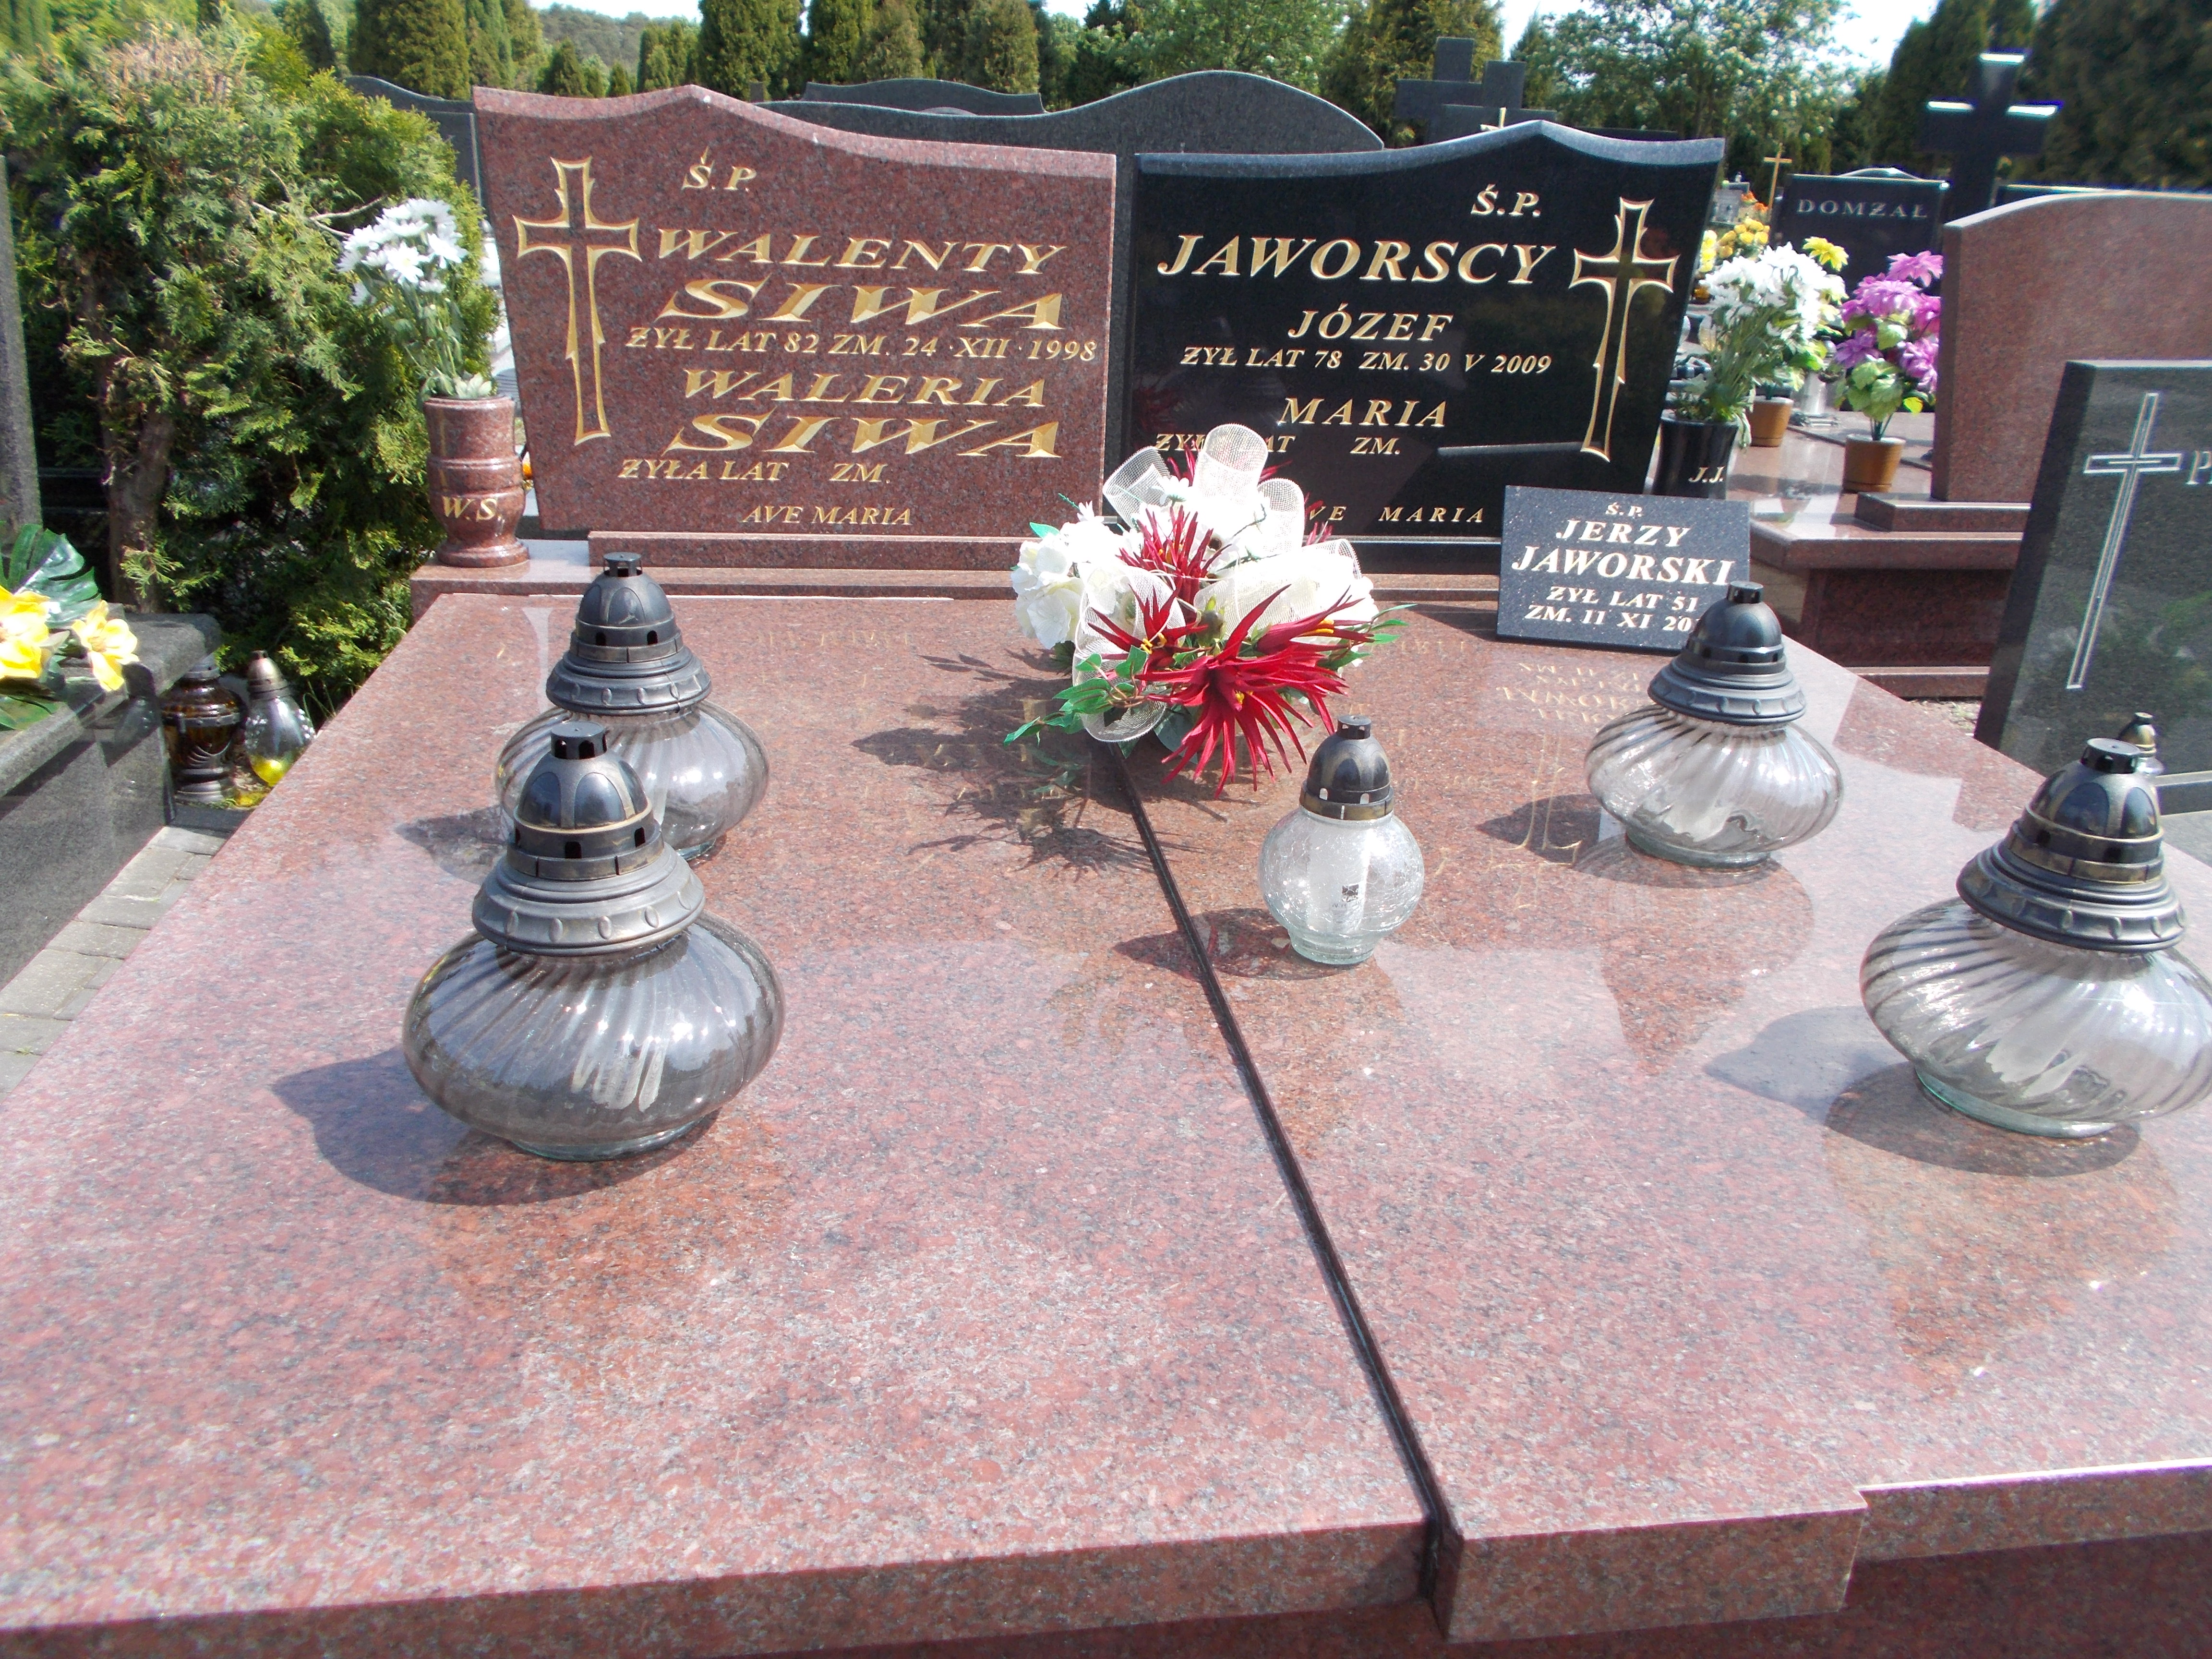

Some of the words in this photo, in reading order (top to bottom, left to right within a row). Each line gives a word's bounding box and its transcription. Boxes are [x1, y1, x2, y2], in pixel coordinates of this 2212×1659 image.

[658, 228, 1067, 275] WALENTY
[1158, 234, 1554, 285] JAWORSCY
[654, 272, 1064, 329] SIWA
[1288, 303, 1453, 342] JÓZEF
[705, 330, 777, 351] LAT
[784, 332, 819, 353] 82
[828, 334, 889, 356] ZM.
[1245, 348, 1305, 367] LAT
[1315, 350, 1342, 368] 78
[1358, 351, 1409, 371] ZM.
[1419, 352, 1451, 372] 30
[1465, 354, 1486, 373] V
[1491, 355, 1551, 373] 2009
[684, 369, 1045, 407] WALERIA
[1278, 397, 1447, 427] MARIA
[661, 407, 1061, 458] SIWA
[1349, 436, 1401, 455] ZM.
[719, 460, 790, 481] LAT
[829, 463, 890, 483] ZM.
[742, 505, 803, 523] AVE
[812, 505, 913, 525] MARIA
[1309, 506, 1347, 521] VE
[1378, 506, 1484, 523] MARIA
[1556, 519, 1691, 547] JERZY
[1512, 545, 1735, 586] JAWORSKI
[1609, 590, 1663, 609] LAT
[1671, 596, 1699, 612] 51
[1524, 605, 1572, 622] ZM.
[1617, 612, 1654, 628] XI
